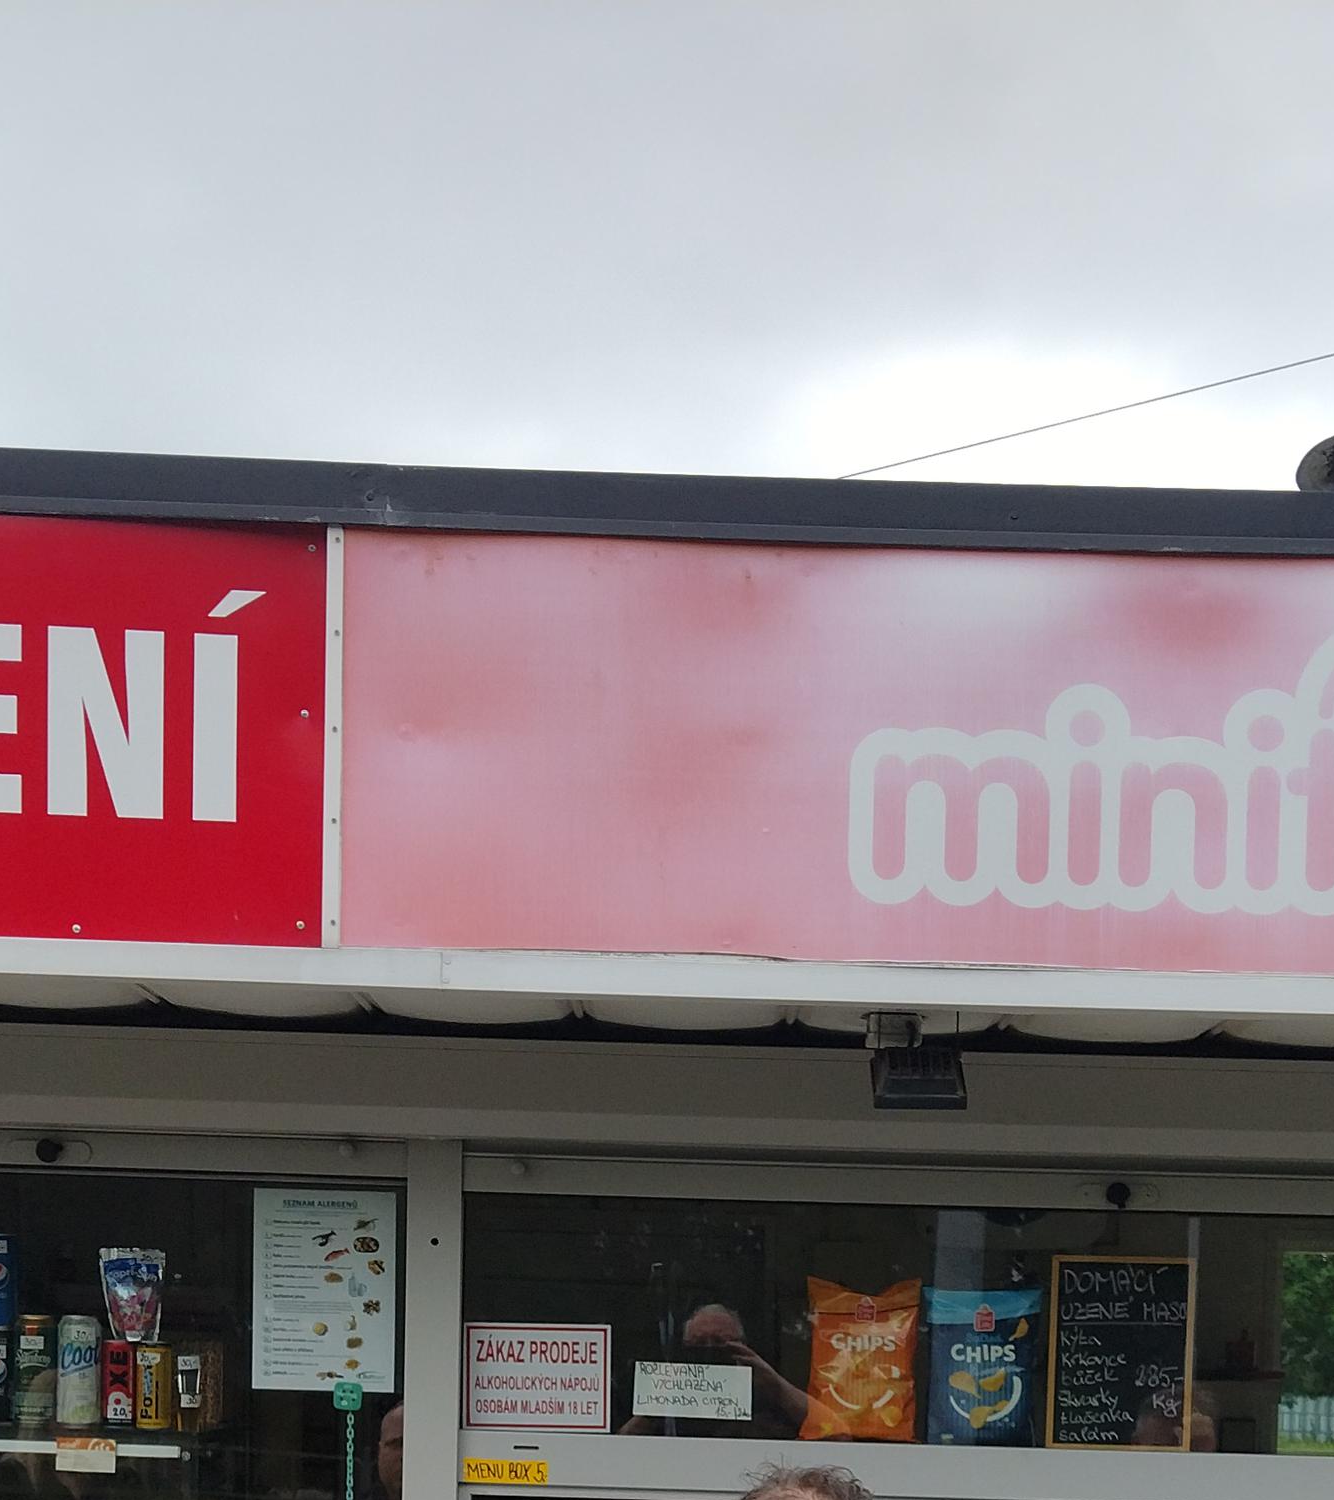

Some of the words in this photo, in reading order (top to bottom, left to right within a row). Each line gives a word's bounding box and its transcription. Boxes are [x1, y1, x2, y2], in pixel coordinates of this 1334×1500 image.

[1064, 1265, 1168, 1295] DOMÁCÍ
[1061, 1296, 1135, 1320] UZENÉ
[476, 1334, 525, 1363] ZÁKAZ
[530, 1340, 598, 1364] PRODEJE
[831, 1333, 896, 1352] CHIPS
[950, 1343, 1016, 1364] CHIPS
[475, 1373, 557, 1391] ALKOHOLICKÝCH
[560, 1374, 600, 1392] NÁPOJŮ
[475, 1398, 518, 1414] OSOBÁM
[521, 1397, 565, 1415] MLADŠÍM
[568, 1401, 578, 1415] 18
[581, 1402, 598, 1415] LET
[467, 1462, 504, 1480] MENU
[508, 1462, 532, 1482] BOX
